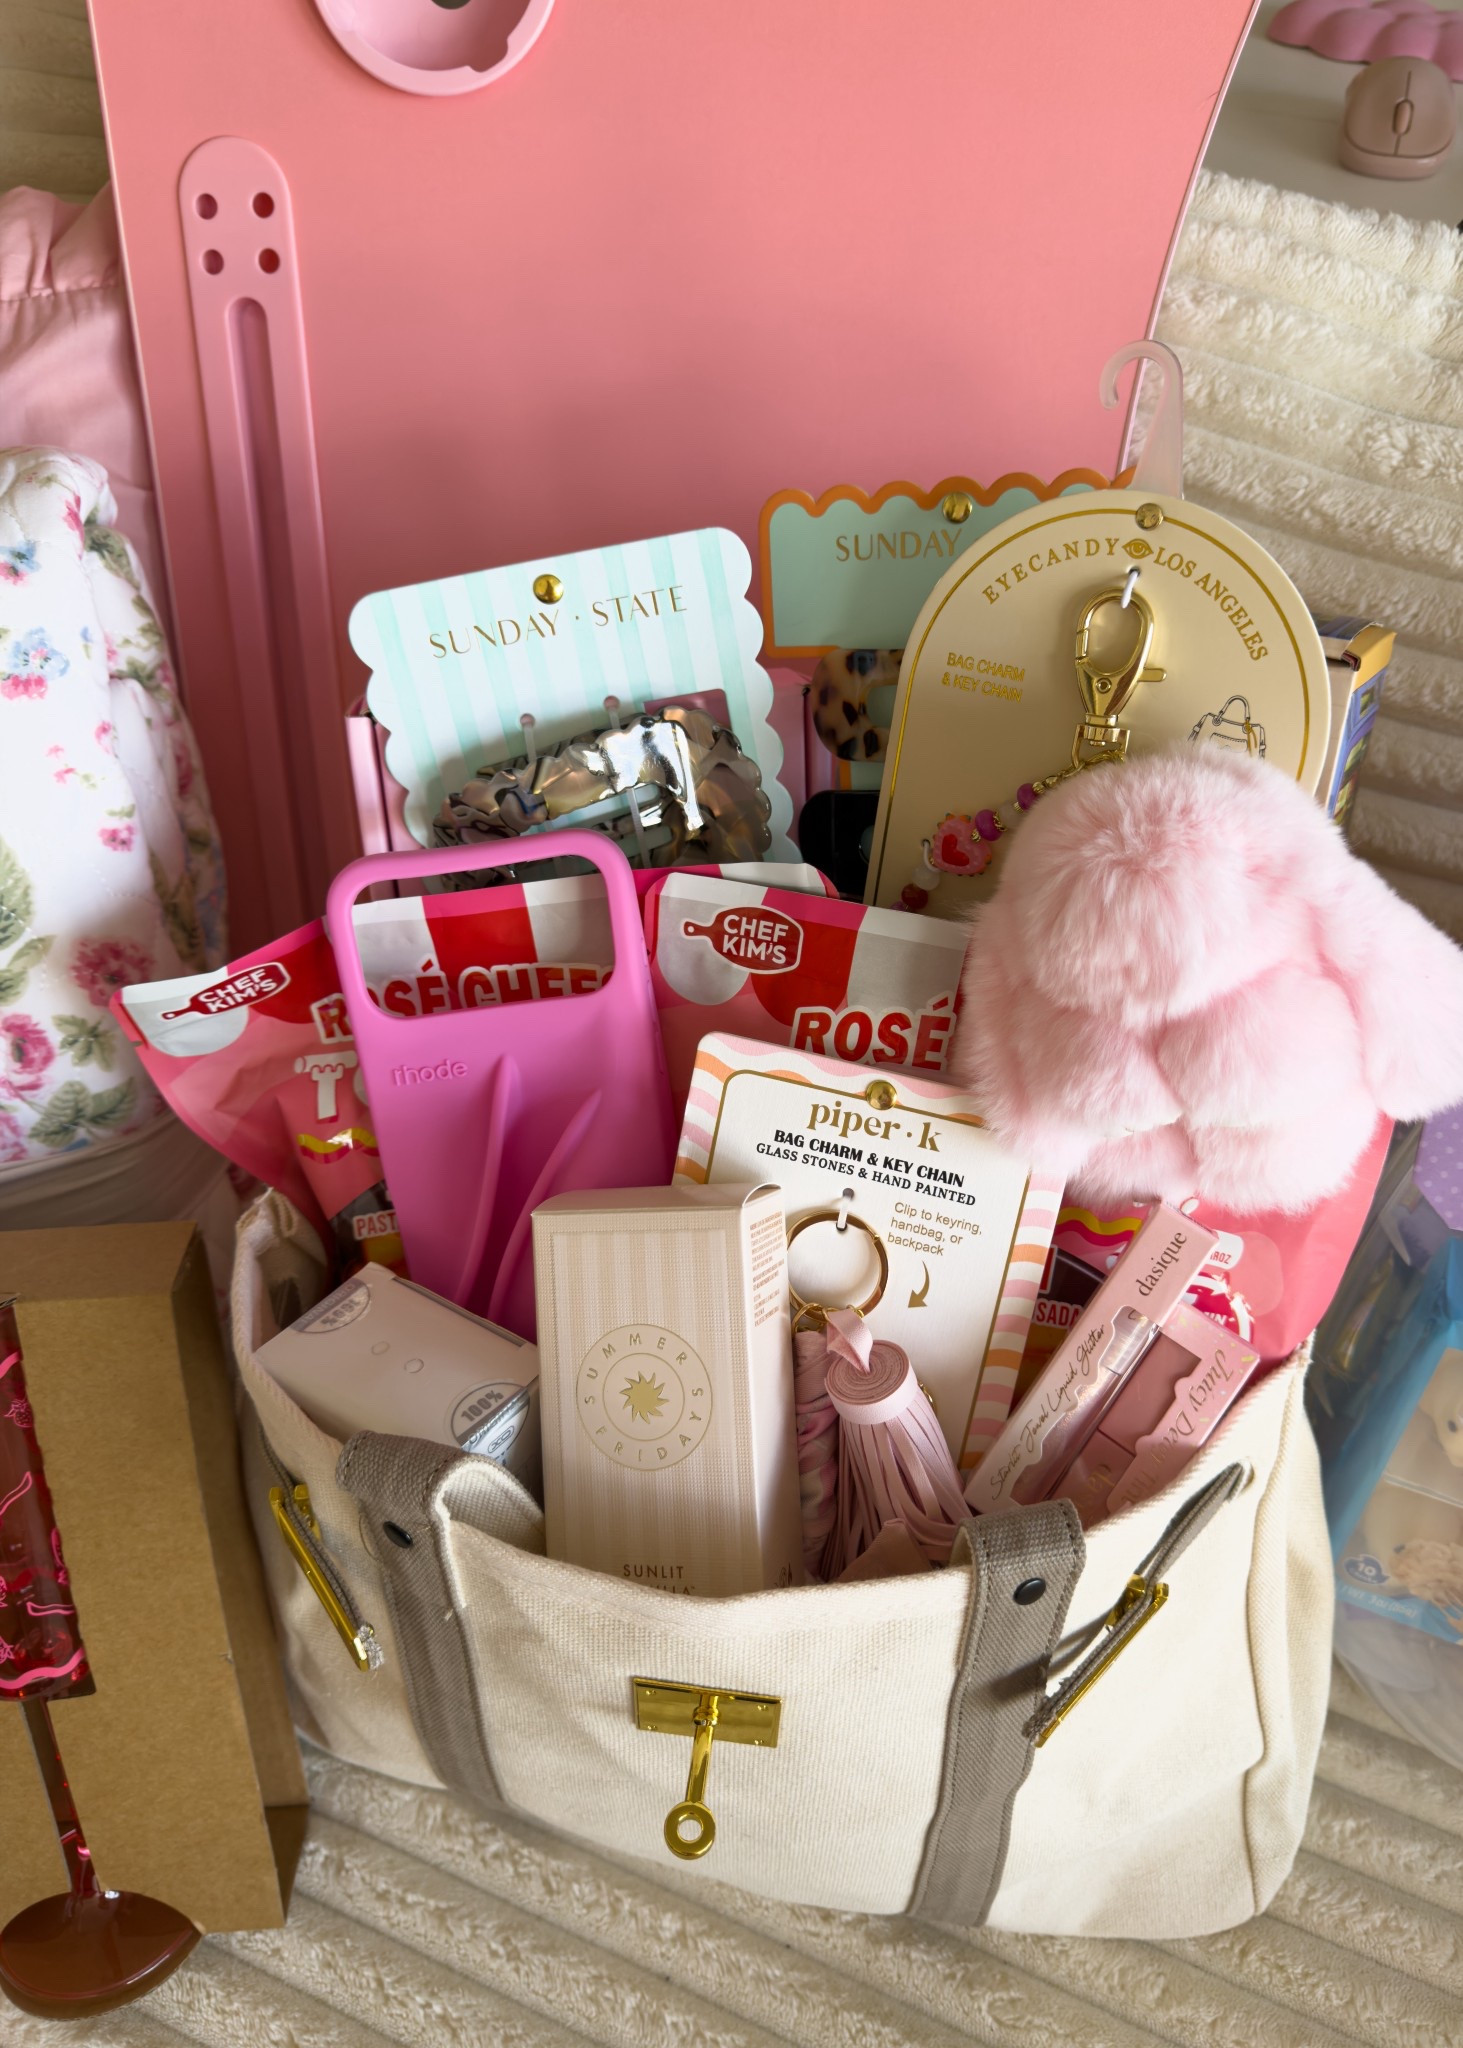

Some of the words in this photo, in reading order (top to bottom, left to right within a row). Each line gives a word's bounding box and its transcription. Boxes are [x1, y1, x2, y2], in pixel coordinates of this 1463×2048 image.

[835, 528, 963, 562] SUNDAY
[982, 537, 1120, 605] EYECANDY
[429, 609, 561, 659] SUNDAY
[591, 584, 688, 628] STATE
[1153, 546, 1198, 579] LOS
[1193, 572, 1269, 662] ANGELES
[946, 651, 975, 672] BAG
[976, 659, 1026, 683] CHARM
[941, 673, 951, 687] &
[953, 674, 980, 692] KEY
[981, 681, 1023, 702] CHAIN
[722, 913, 790, 943] CHEF
[722, 933, 788, 966] KIM'S
[199, 967, 267, 1004] CHEF
[204, 978, 278, 1013] KIM'S
[794, 997, 952, 1071] ROSÉ
[393, 1059, 468, 1086] rhode
[756, 1142, 800, 1162] GLASS
[801, 1153, 855, 1176] STONES
[857, 1166, 868, 1179] &
[871, 1171, 912, 1192] HAND
[915, 1181, 976, 1206] PAINTED
[774, 1129, 805, 1149] BAG
[808, 1138, 863, 1163] CHARM
[867, 1152, 879, 1166] &
[883, 1155, 914, 1176] KEY
[916, 1164, 965, 1188] CHAIN
[890, 1216, 946, 1245] handbag,
[949, 1233, 963, 1245] or
[894, 1201, 917, 1222] Clip
[920, 1208, 932, 1222] to
[935, 1211, 983, 1236] keyring,
[887, 1231, 945, 1257] backpack
[1210, 1251, 1232, 1265] ROZ
[1136, 1230, 1188, 1298] dasique
[584, 1332, 688, 1404] SUMMER
[1188, 1348, 1234, 1412] Juicy
[460, 1390, 504, 1422] 100%
[595, 1387, 704, 1462] FRIDAYS
[623, 1563, 684, 1579] SUNLIT
